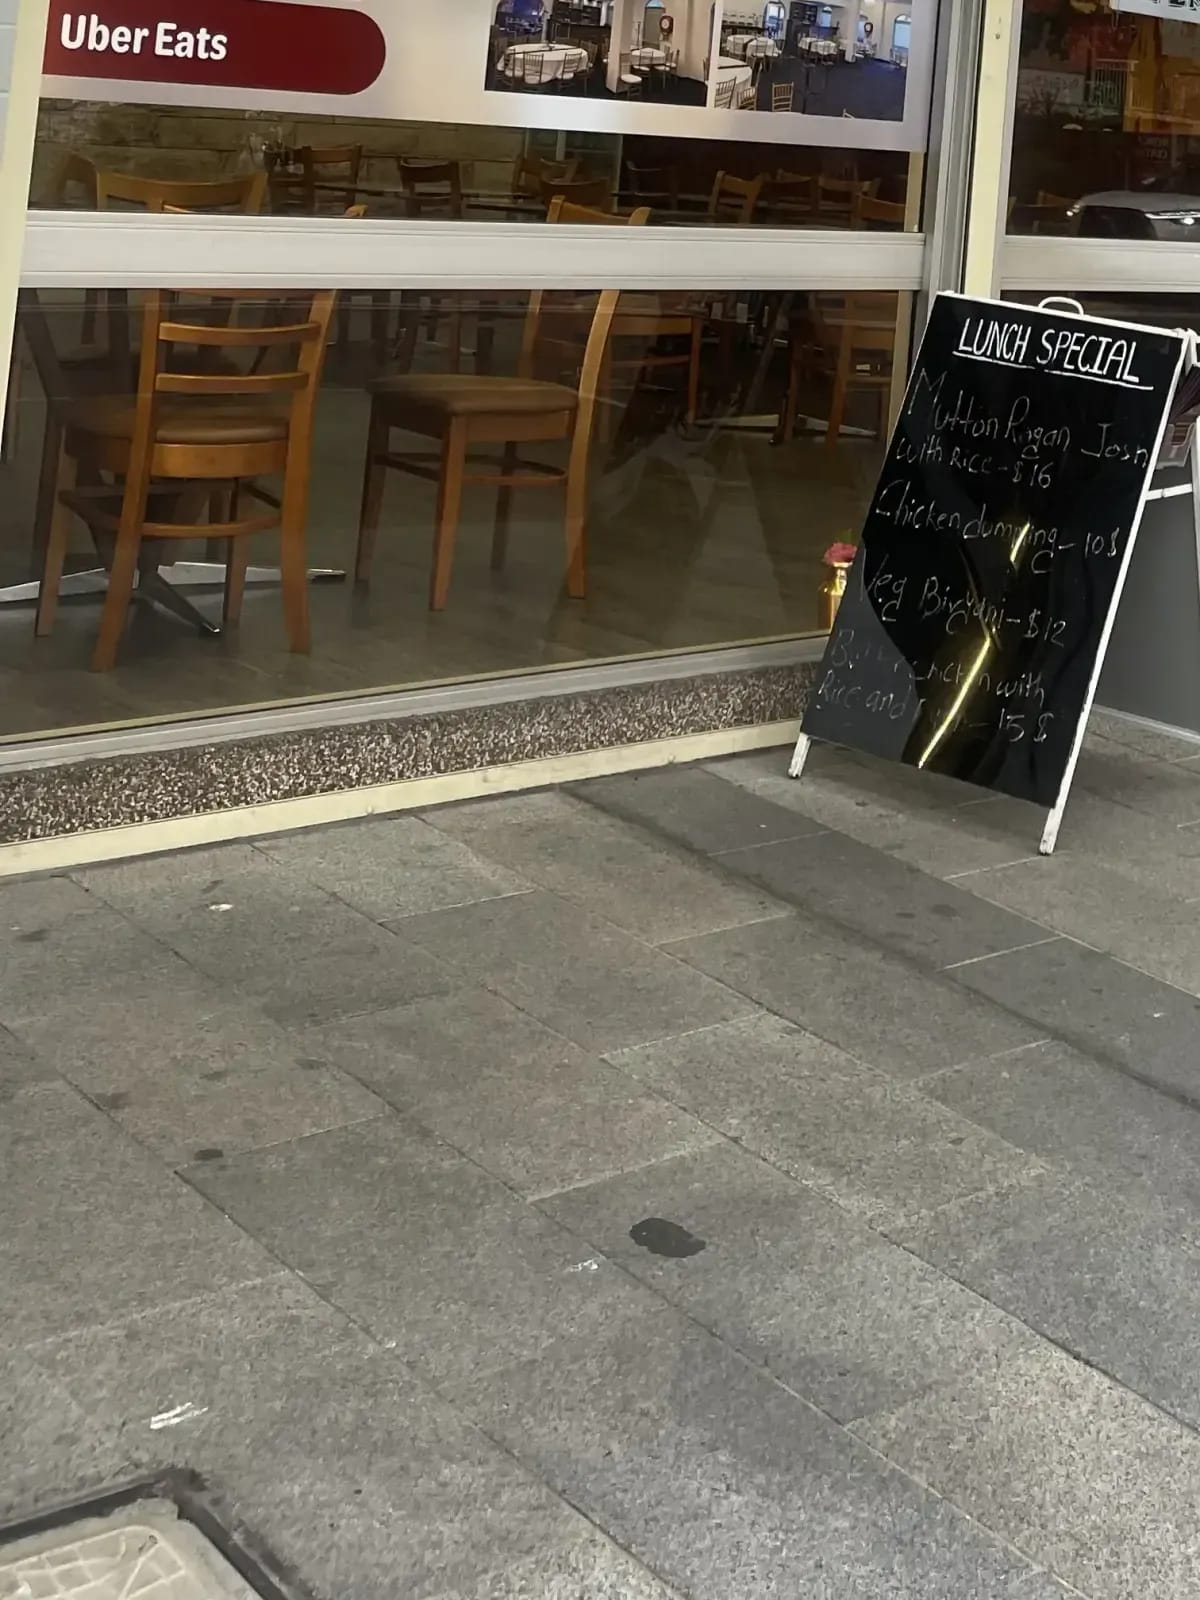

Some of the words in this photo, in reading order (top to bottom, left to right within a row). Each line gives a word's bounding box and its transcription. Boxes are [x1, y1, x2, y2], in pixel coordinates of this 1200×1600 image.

[60, 13, 149, 54] Uber
[155, 22, 228, 60] Eats
[958, 317, 1032, 363] LUNCH
[1036, 329, 1140, 383] SPECIAL
[908, 367, 1000, 438] Mutton
